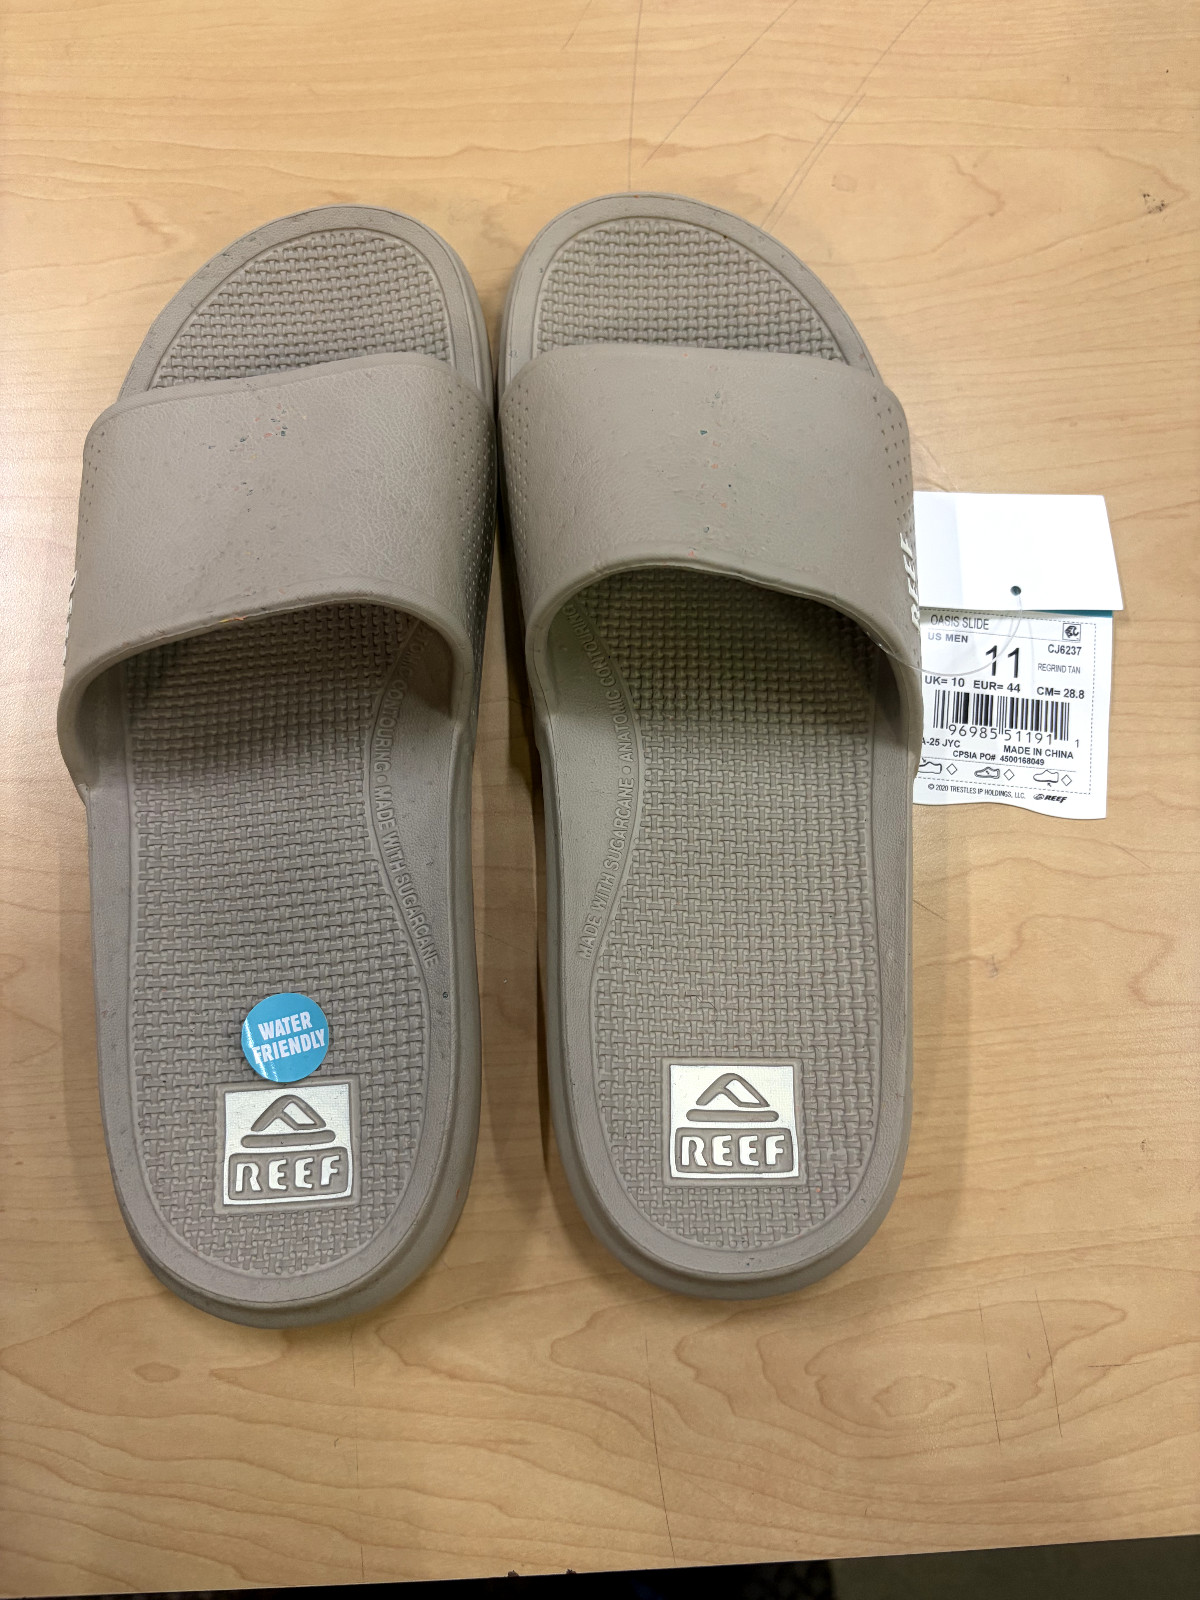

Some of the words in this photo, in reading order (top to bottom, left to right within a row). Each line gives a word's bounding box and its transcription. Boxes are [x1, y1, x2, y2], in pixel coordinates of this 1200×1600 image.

[930, 614, 960, 628] OASIS
[962, 617, 990, 631] SLIDE
[562, 603, 617, 688] CONTOURING
[927, 632, 942, 641] US
[945, 634, 969, 644] MEN
[1047, 644, 1082, 656] CJ6237
[985, 645, 1020, 678] 11
[1037, 663, 1067, 673] REGRIND
[1068, 665, 1081, 674] TAN
[924, 675, 948, 686] UK=
[951, 677, 965, 688] 10
[973, 680, 1004, 691] EUR=
[1007, 683, 1021, 693] 44
[1036, 687, 1061, 697] CM=
[1063, 688, 1085, 700] 28.8
[374, 678, 407, 773] CONTOURING
[605, 689, 635, 763] ANATOMIC
[948, 724, 998, 740] 96985
[1004, 731, 1053, 746] 51191
[1075, 739, 1080, 749] 1
[942, 738, 961, 749] JYC
[952, 750, 977, 760] CPSIA
[979, 752, 996, 761] PO#
[1000, 754, 1045, 766] 4500168049
[1003, 745, 1031, 756] MADE
[1033, 748, 1043, 757] IN
[1044, 749, 1074, 760] CHINA
[935, 784, 949, 792] 2020
[950, 785, 977, 795] TRESTLES
[1044, 795, 1067, 803] REEF
[374, 785, 396, 831] MADE
[602, 777, 635, 872] SUGARCANE
[382, 830, 408, 873] WITH
[591, 871, 616, 911] WITH
[395, 872, 440, 969] SUGARCANE
[576, 912, 602, 960] MADE
[258, 1011, 313, 1041] WATER
[252, 1029, 326, 1065] FRIENDLY
[681, 1135, 785, 1167] REEF
[235, 1155, 341, 1192] REEF
